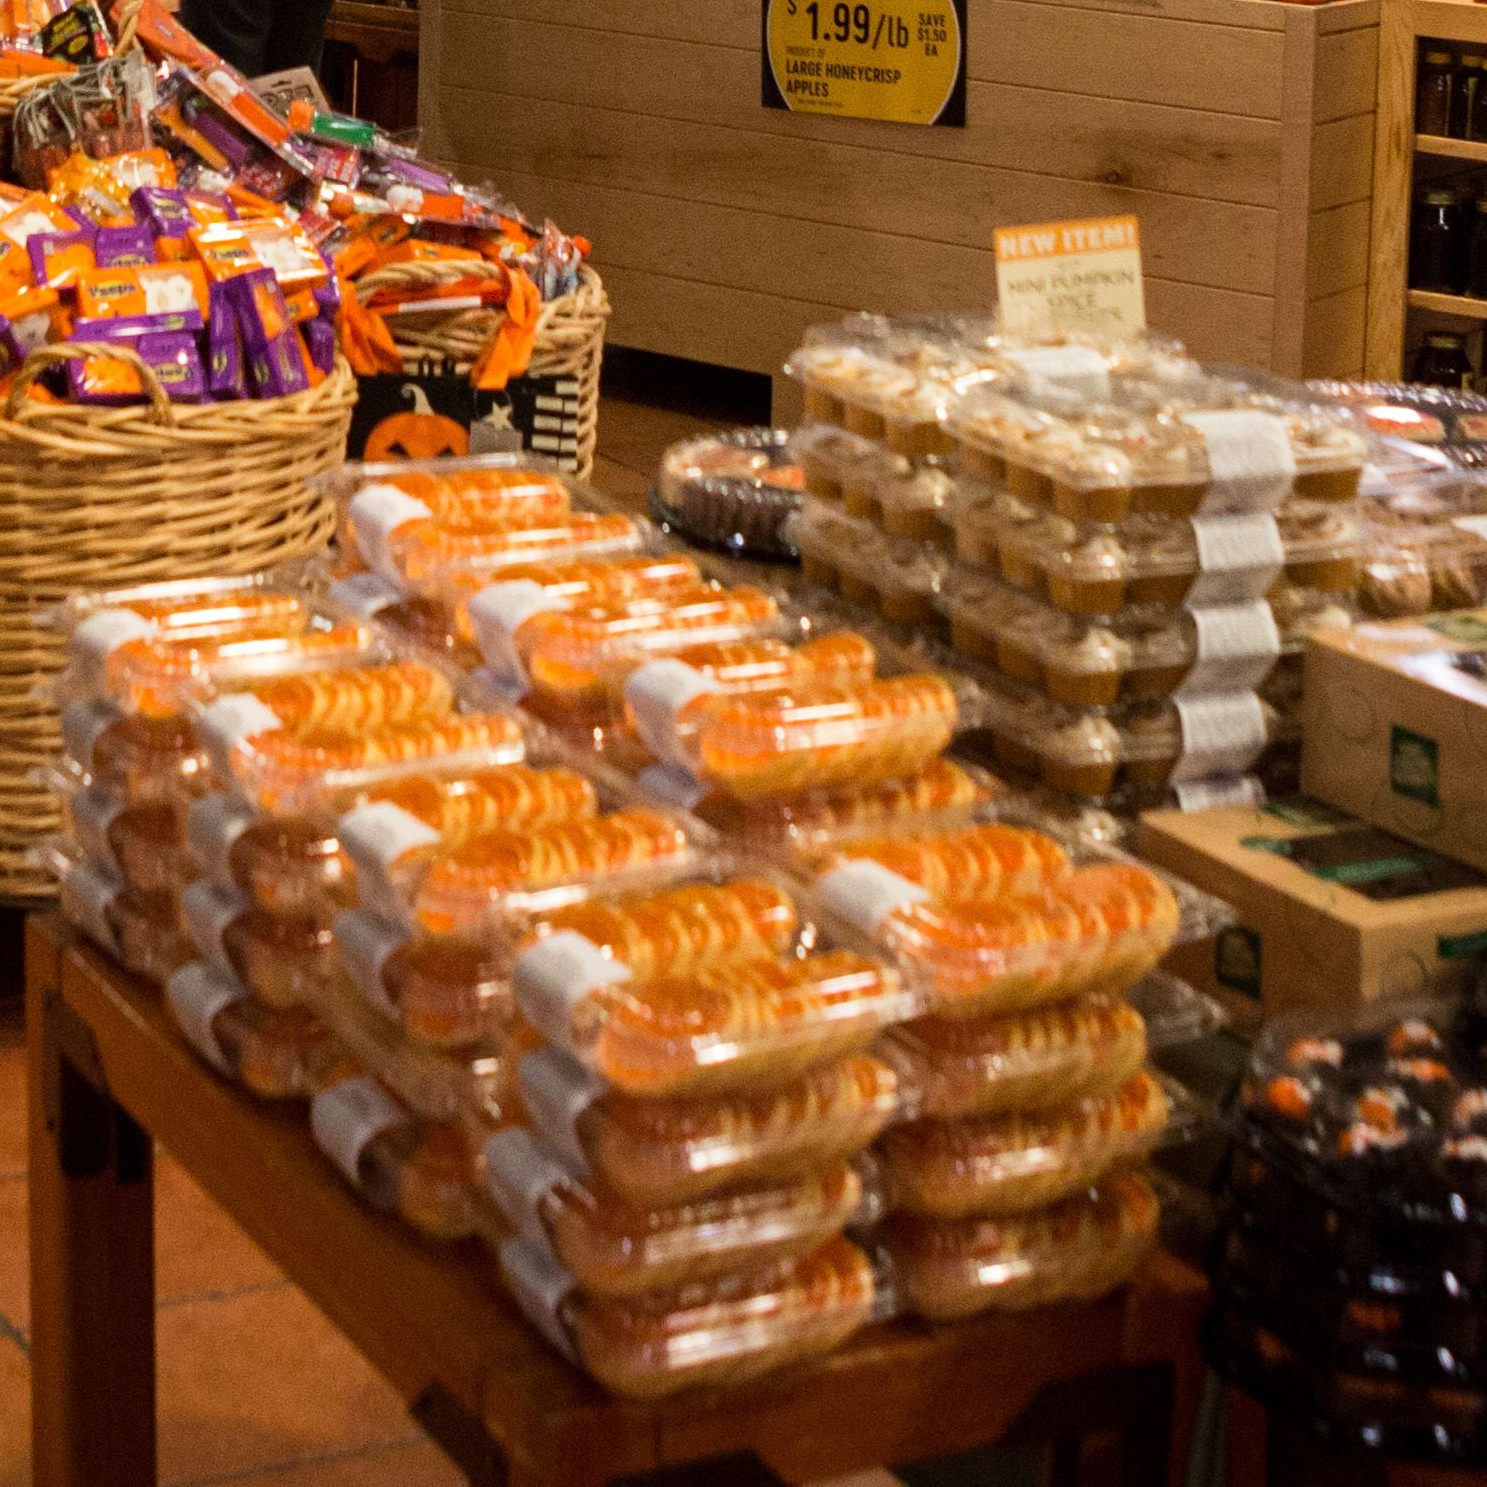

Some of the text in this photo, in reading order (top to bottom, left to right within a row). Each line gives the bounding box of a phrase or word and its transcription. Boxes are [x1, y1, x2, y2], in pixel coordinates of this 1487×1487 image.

[806, 2, 910, 50] 1.99/lb
[918, 13, 946, 28] SAVE
[785, 59, 902, 85] LARGE HONEYCRISP
[785, 79, 830, 97] APPLES
[999, 223, 1135, 259] NEW ITEM!
